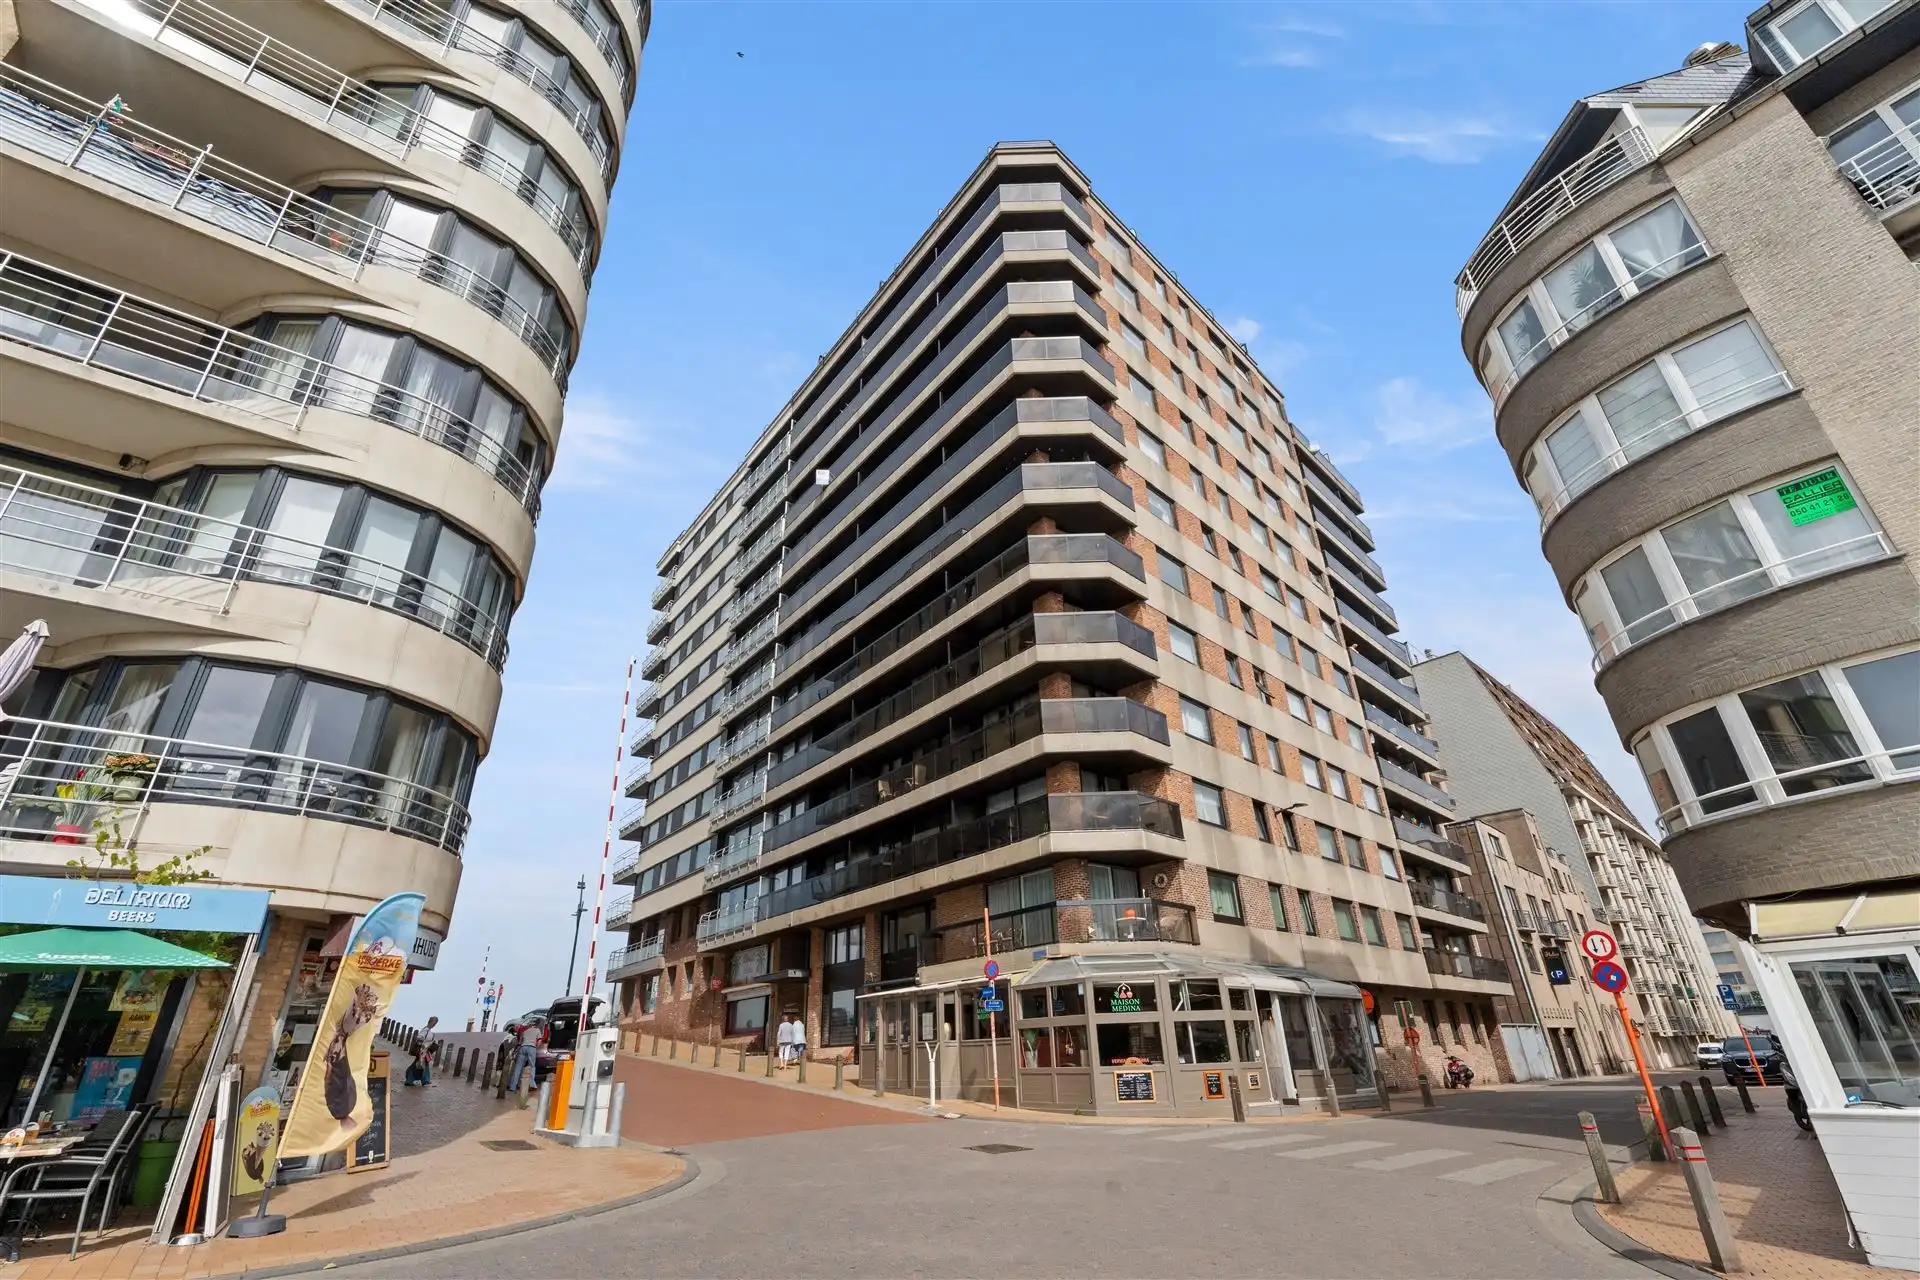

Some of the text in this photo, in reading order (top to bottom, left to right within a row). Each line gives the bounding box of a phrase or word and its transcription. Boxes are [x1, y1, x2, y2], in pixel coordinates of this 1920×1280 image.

[1800, 471, 1836, 489] HUUR
[1789, 506, 1808, 517] 050
[1809, 502, 1822, 510] 41
[84, 887, 192, 909] DELIRIUM
[108, 910, 157, 924] BEERS
[1720, 986, 1729, 996] P
[1110, 998, 1140, 1006] MAISON
[1111, 1004, 1141, 1012] MEDINA
